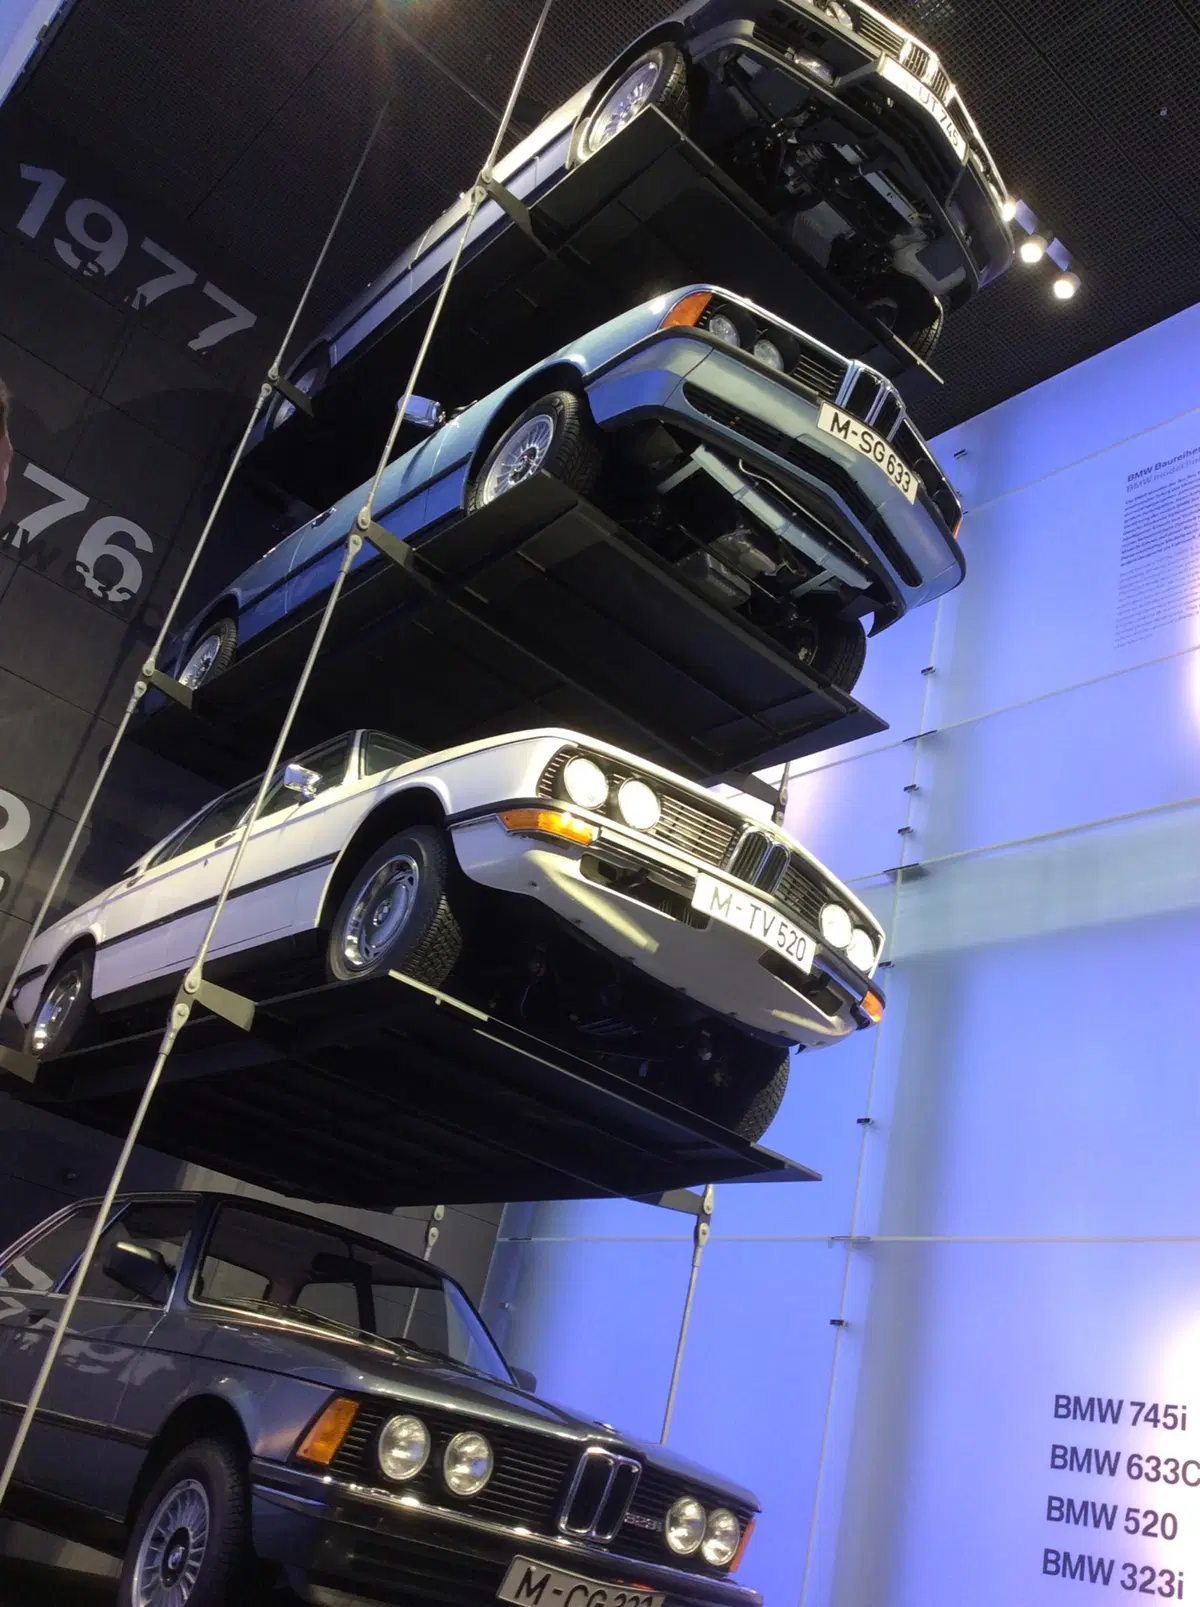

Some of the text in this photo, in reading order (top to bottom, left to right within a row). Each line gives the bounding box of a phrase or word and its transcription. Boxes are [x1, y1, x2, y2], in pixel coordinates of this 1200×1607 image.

[16, 162, 258, 355] 1977
[830, 411, 911, 493] M-SG 633
[1127, 465, 1153, 482] BMW
[710, 886, 807, 961] M-TV 520
[1053, 1394, 1187, 1431] BMW 745i
[1050, 1444, 1200, 1487] BMW 633C
[1046, 1495, 1178, 1540] BMW 520
[1042, 1548, 1184, 1600] BMW 323i
